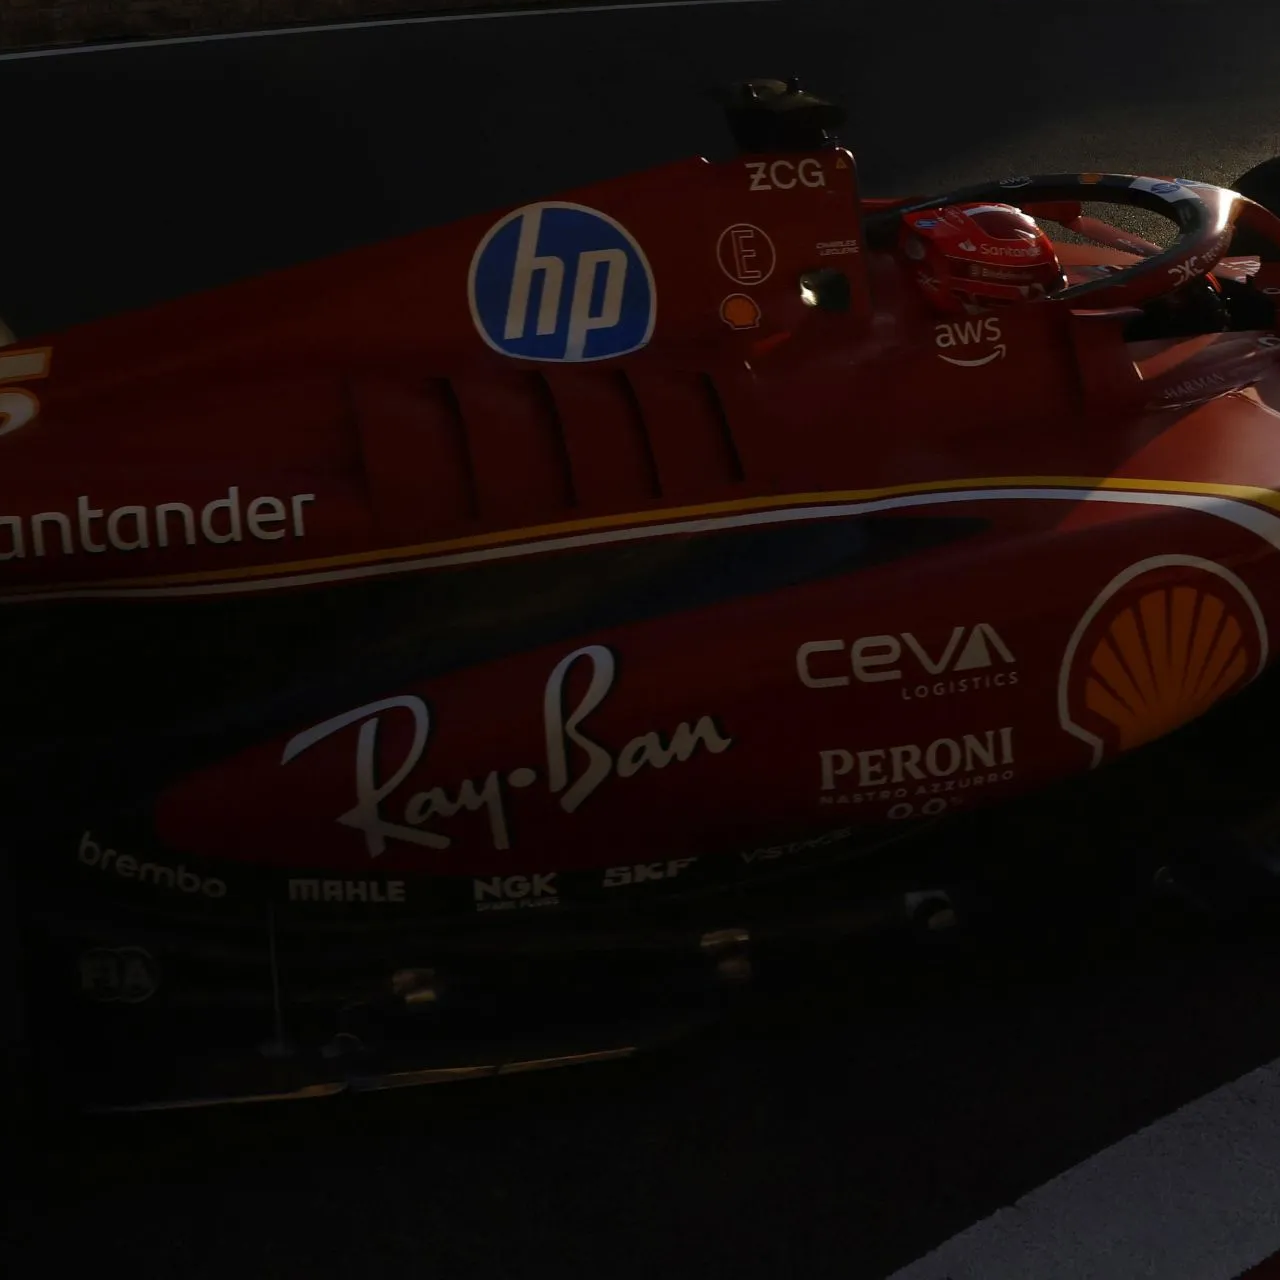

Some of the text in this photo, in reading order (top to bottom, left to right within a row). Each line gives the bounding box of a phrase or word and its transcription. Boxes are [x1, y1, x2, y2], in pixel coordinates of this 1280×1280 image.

[743, 158, 827, 192] ZCG
[503, 202, 629, 361] hp
[934, 317, 1003, 349] aws
[900, 671, 1020, 701] LOGISTICS
[816, 725, 1016, 792] PERONI
[817, 769, 1015, 807] NASTRO AZZURRO
[76, 828, 228, 900] brembo
[601, 854, 704, 889] SKF
[287, 877, 408, 903] MAHLE
[473, 871, 559, 901] NGK
